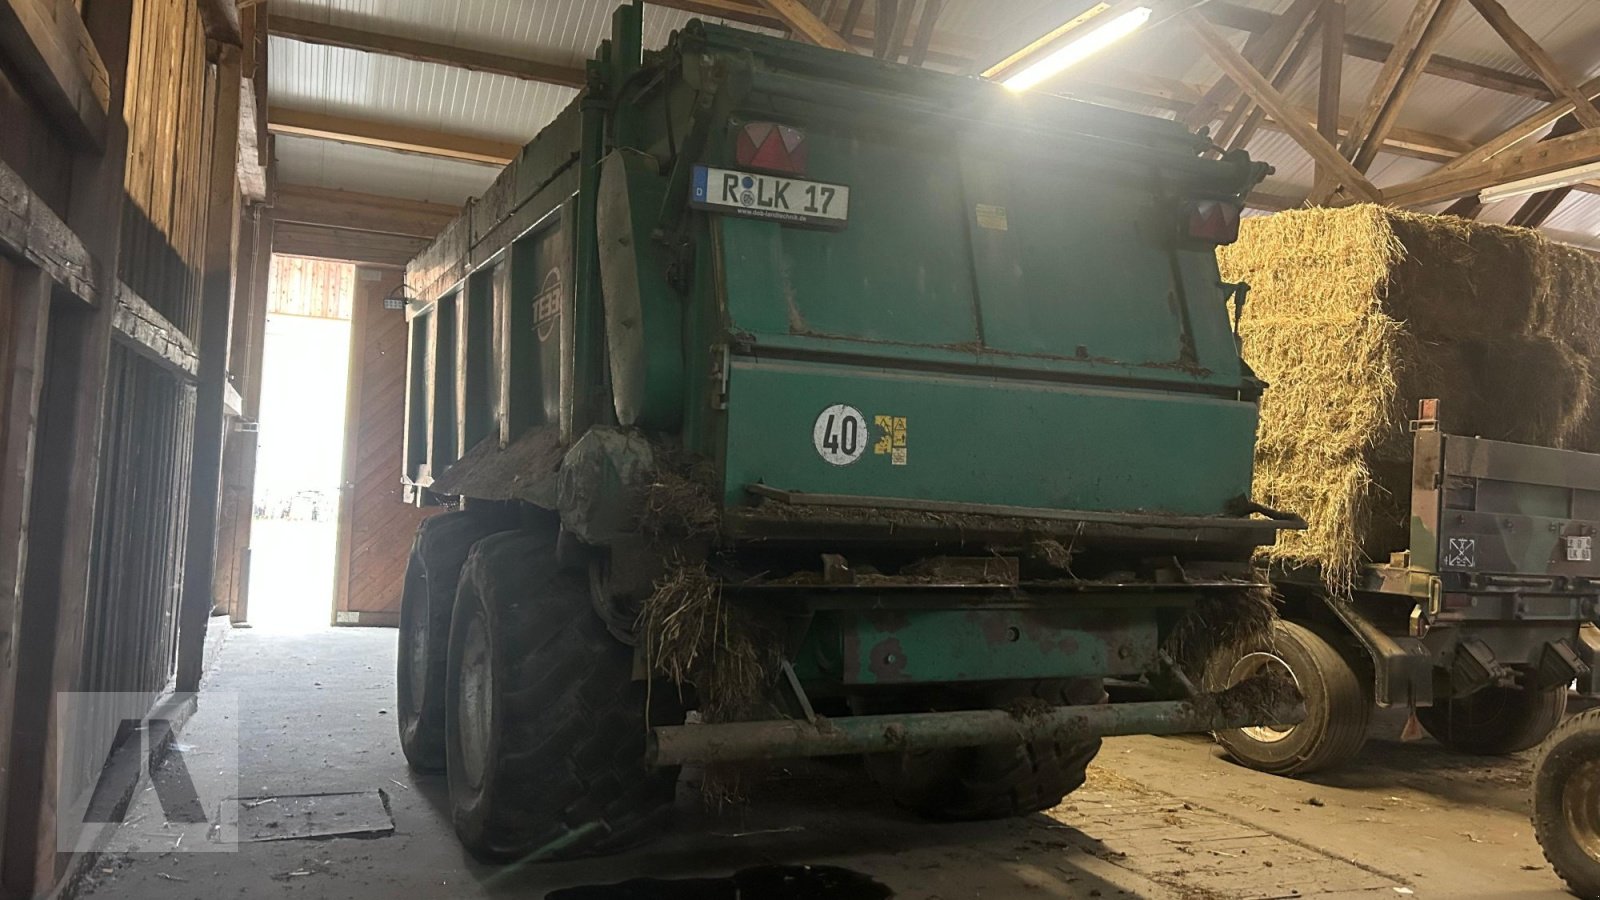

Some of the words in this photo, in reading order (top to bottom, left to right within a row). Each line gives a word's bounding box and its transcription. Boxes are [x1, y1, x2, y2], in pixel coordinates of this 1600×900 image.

[722, 173, 738, 203] R
[757, 178, 791, 209] LK
[804, 185, 836, 214] 17
[823, 414, 858, 455] 40
